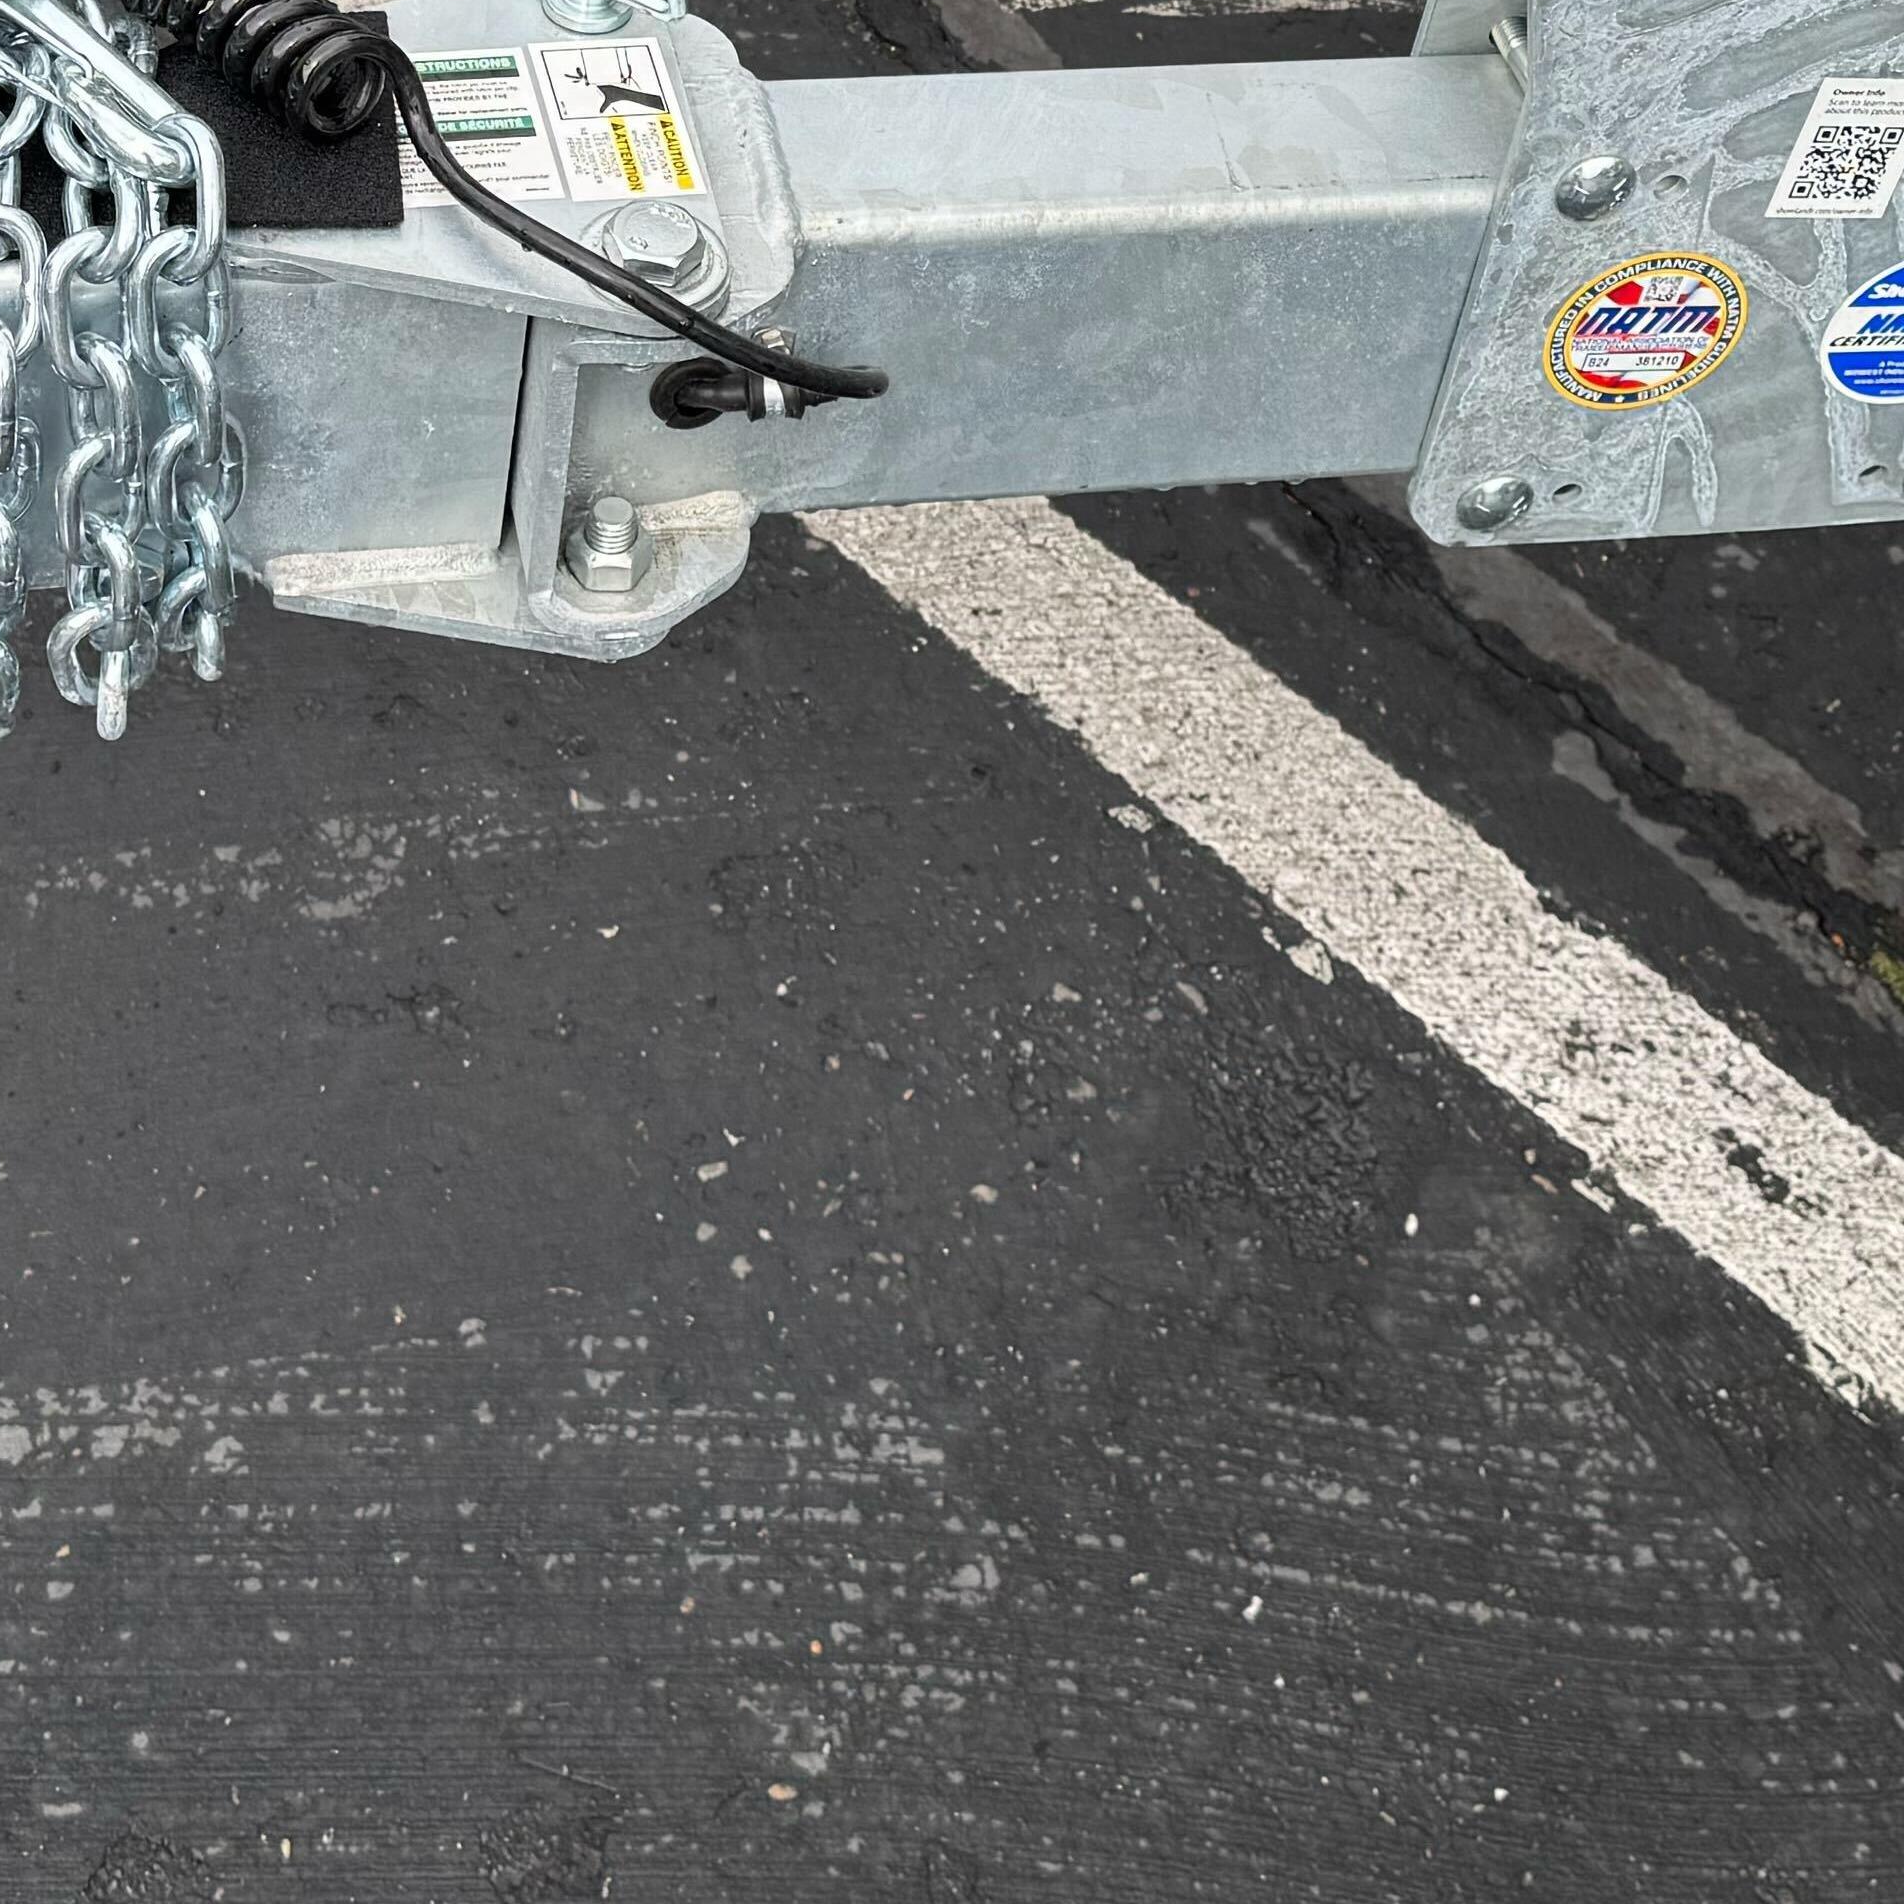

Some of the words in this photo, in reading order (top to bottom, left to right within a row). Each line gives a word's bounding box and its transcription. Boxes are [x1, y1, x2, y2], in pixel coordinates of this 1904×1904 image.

[416, 58, 511, 73] STRUCTIONS
[1828, 98, 1849, 106] Scan
[1863, 98, 1886, 107] learn
[1833, 88, 1864, 96] Owner
[616, 132, 643, 191] ATTENTION
[663, 130, 689, 176] CAUTION
[1595, 258, 1707, 292] COMPLIANCE
[1707, 265, 1737, 297] WITH
[1576, 292, 1594, 308] IN
[1576, 306, 1721, 336] NATM
[1726, 298, 1740, 340] NATM
[1551, 311, 1603, 402] MANUFACTURED
[1588, 357, 1610, 367] B24
[1637, 342, 1727, 401] GUIDELINES
